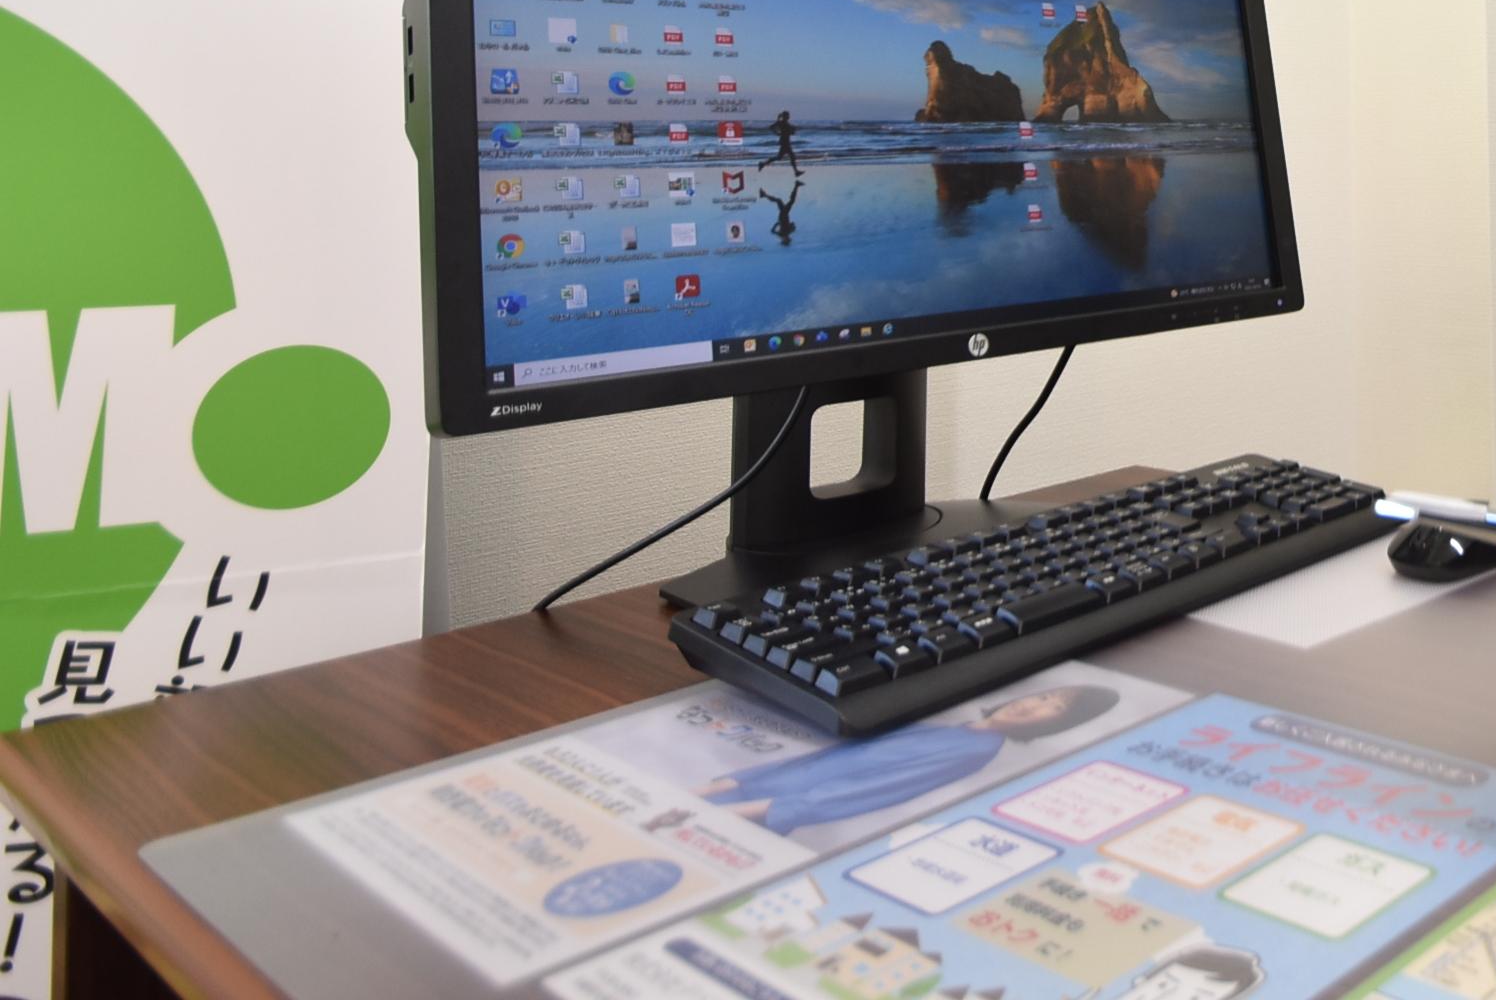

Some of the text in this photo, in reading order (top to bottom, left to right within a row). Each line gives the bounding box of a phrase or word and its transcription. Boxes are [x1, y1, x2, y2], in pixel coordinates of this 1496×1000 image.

[538, 360, 607, 377] ここに入力して検索
[502, 401, 542, 416] Display
